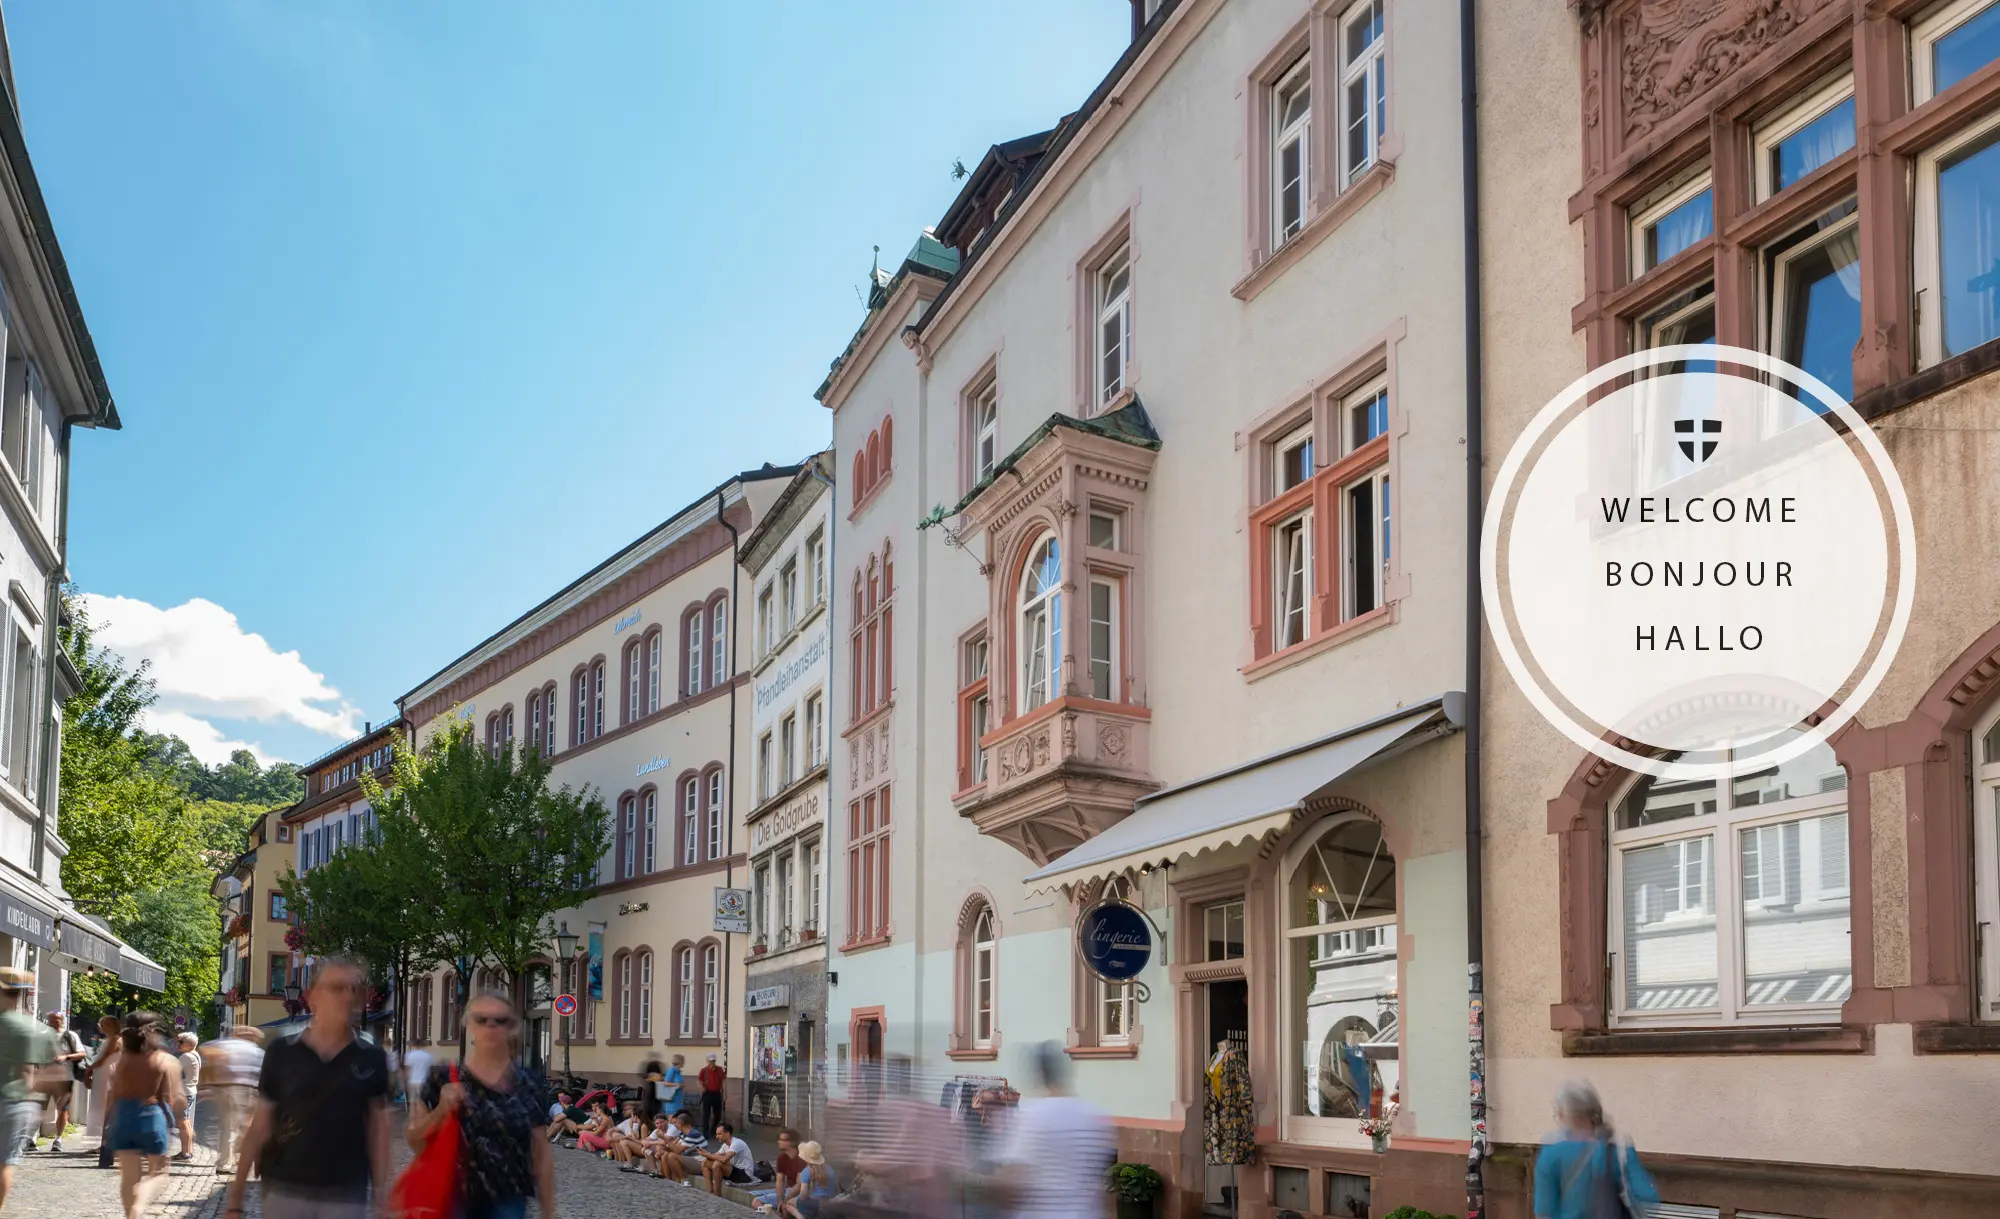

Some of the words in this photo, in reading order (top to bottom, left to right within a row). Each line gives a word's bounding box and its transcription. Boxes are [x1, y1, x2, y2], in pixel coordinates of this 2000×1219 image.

[757, 632, 825, 713] Pfandleihanstalt
[758, 822, 770, 846] Die
[774, 793, 818, 837] Goldgrube
